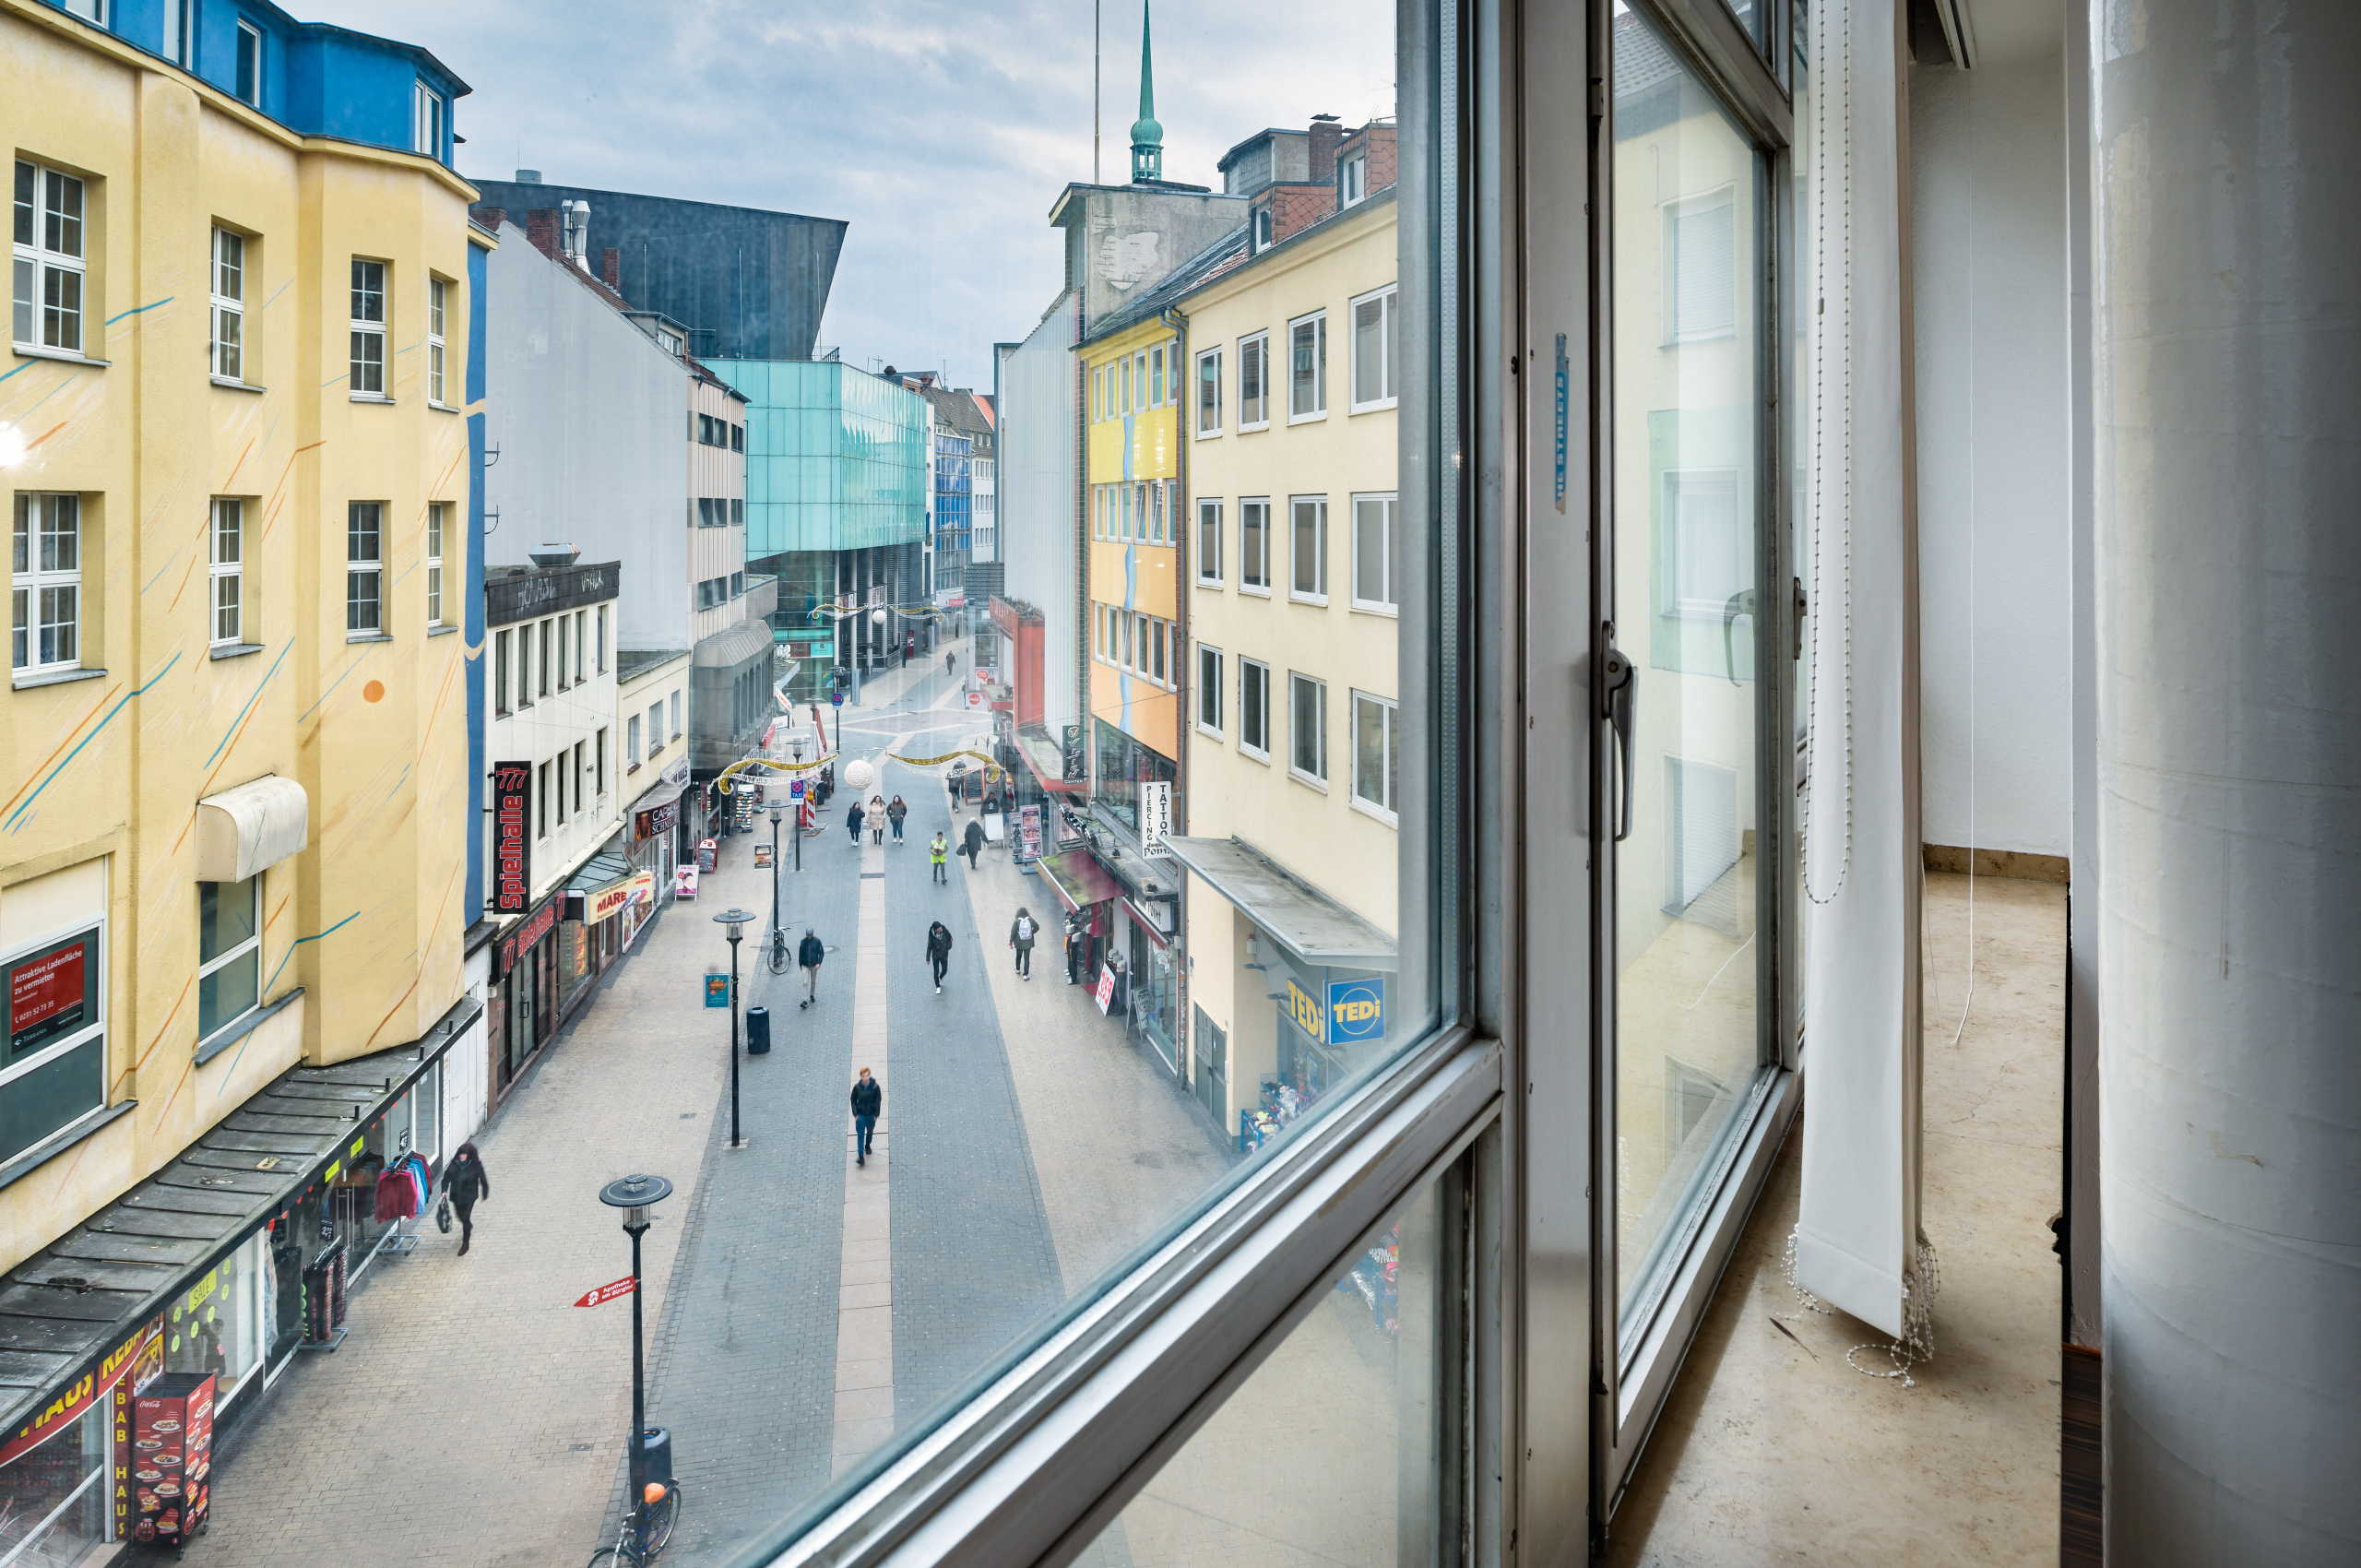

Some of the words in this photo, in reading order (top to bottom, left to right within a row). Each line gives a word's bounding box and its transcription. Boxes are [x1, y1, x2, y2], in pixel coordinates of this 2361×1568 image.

[496, 768, 528, 791] 777
[499, 795, 526, 909] Spielhalle
[597, 891, 628, 914] MARE
[503, 937, 516, 973] 777
[518, 905, 554, 957] Spielhalle
[555, 890, 566, 921] 777
[15, 966, 46, 984] Attraktive
[47, 950, 83, 970] Ladenfläche
[24, 972, 55, 992] vermieten
[19, 1012, 32, 1021] 0231
[41, 1004, 47, 1012] 73
[48, 1000, 54, 1008] 35
[1287, 980, 1324, 1044] TEDi
[1333, 999, 1381, 1023] TEDi
[194, 1277, 210, 1307] SALE
[601, 1291, 611, 1300] am
[603, 1279, 630, 1293] Apotheke
[139, 1400, 161, 1408] Coca-Cola
[116, 1467, 127, 1535] HAUS
